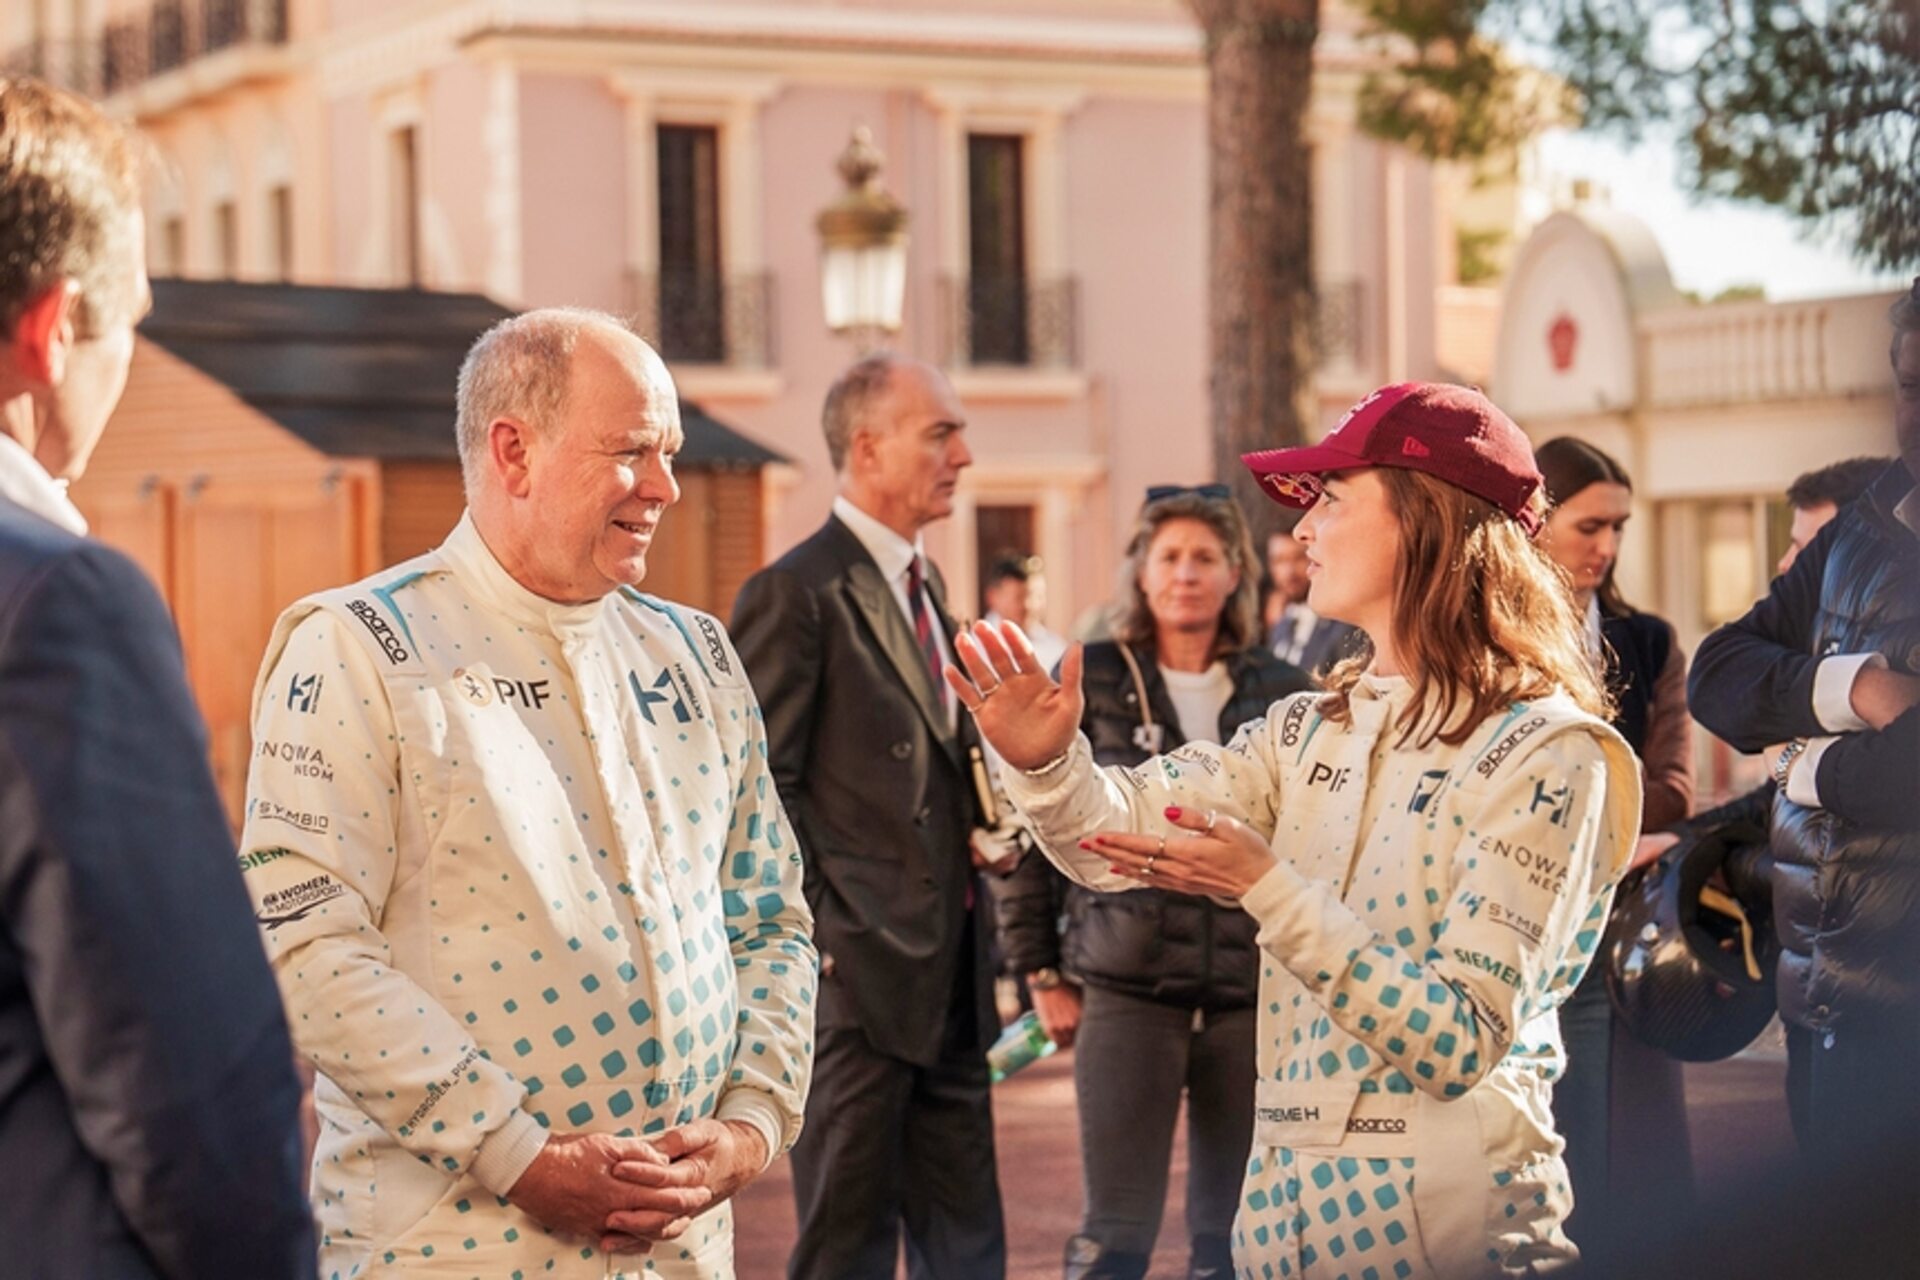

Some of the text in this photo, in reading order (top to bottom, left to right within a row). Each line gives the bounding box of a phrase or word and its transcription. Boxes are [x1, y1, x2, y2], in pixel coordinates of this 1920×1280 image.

[346, 600, 408, 665] sparco
[492, 678, 550, 710] PIF
[1477, 717, 1548, 779] sparco
[294, 764, 334, 783] NEOM
[279, 874, 330, 900] WOMEN
